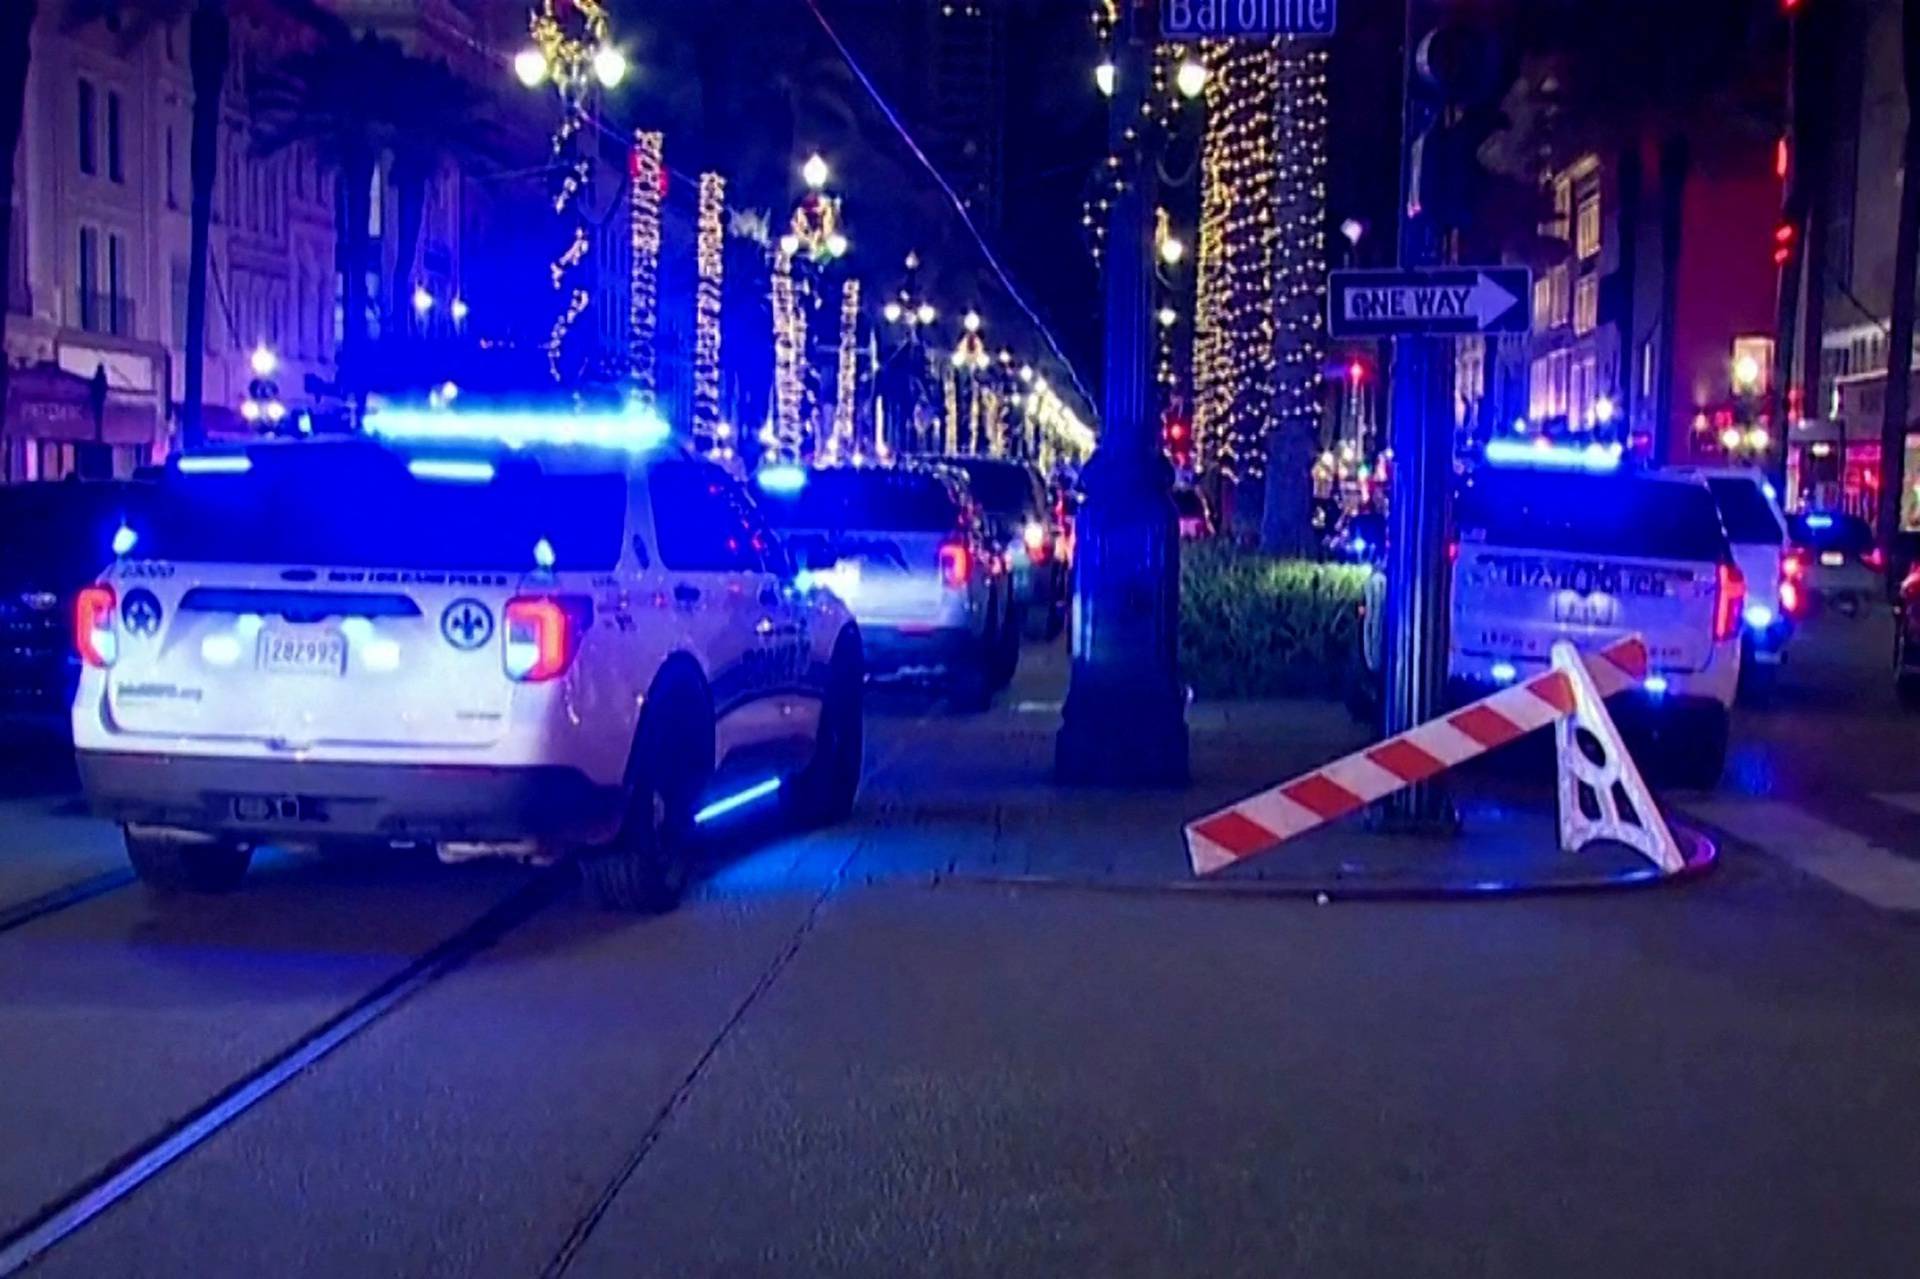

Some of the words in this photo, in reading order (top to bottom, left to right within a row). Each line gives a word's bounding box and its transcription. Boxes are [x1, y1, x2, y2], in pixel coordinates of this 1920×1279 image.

[1170, 0, 1326, 29] Baronne
[1352, 289, 1406, 318] ONE
[1415, 287, 1470, 314] WAY
